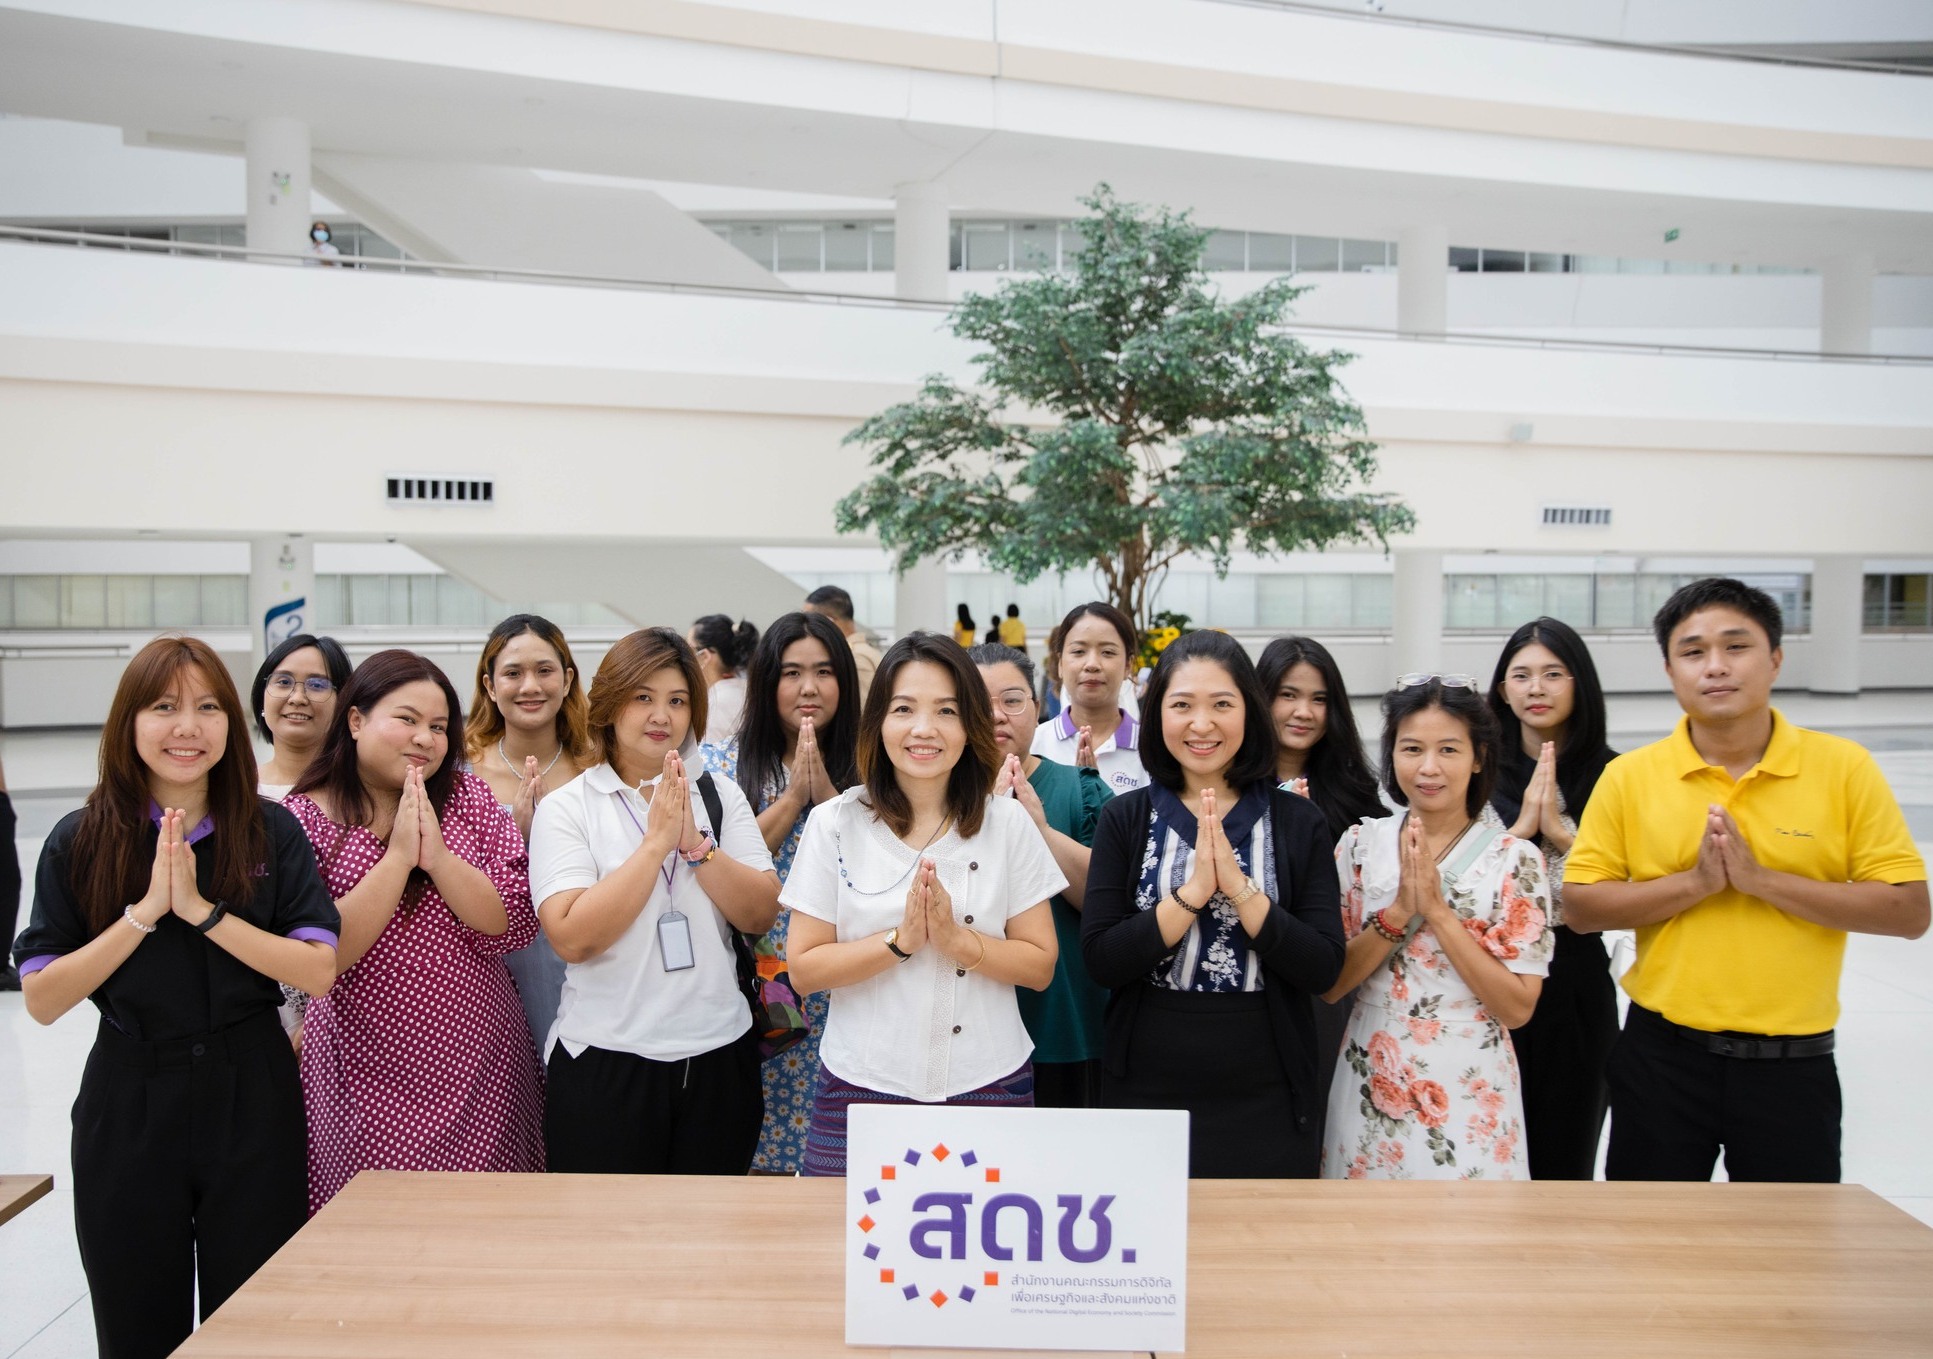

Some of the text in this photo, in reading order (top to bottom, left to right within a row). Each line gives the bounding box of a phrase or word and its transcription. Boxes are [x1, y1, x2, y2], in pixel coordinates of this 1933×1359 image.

[909, 1191, 1137, 1264] สดช.
[1011, 1274, 1172, 1288] สำนักงานคณะกรรมการดิจิทัล
[1011, 1288, 1177, 1305] เพื่อเศรษฐกิจและสังคมแห่งชาติ
